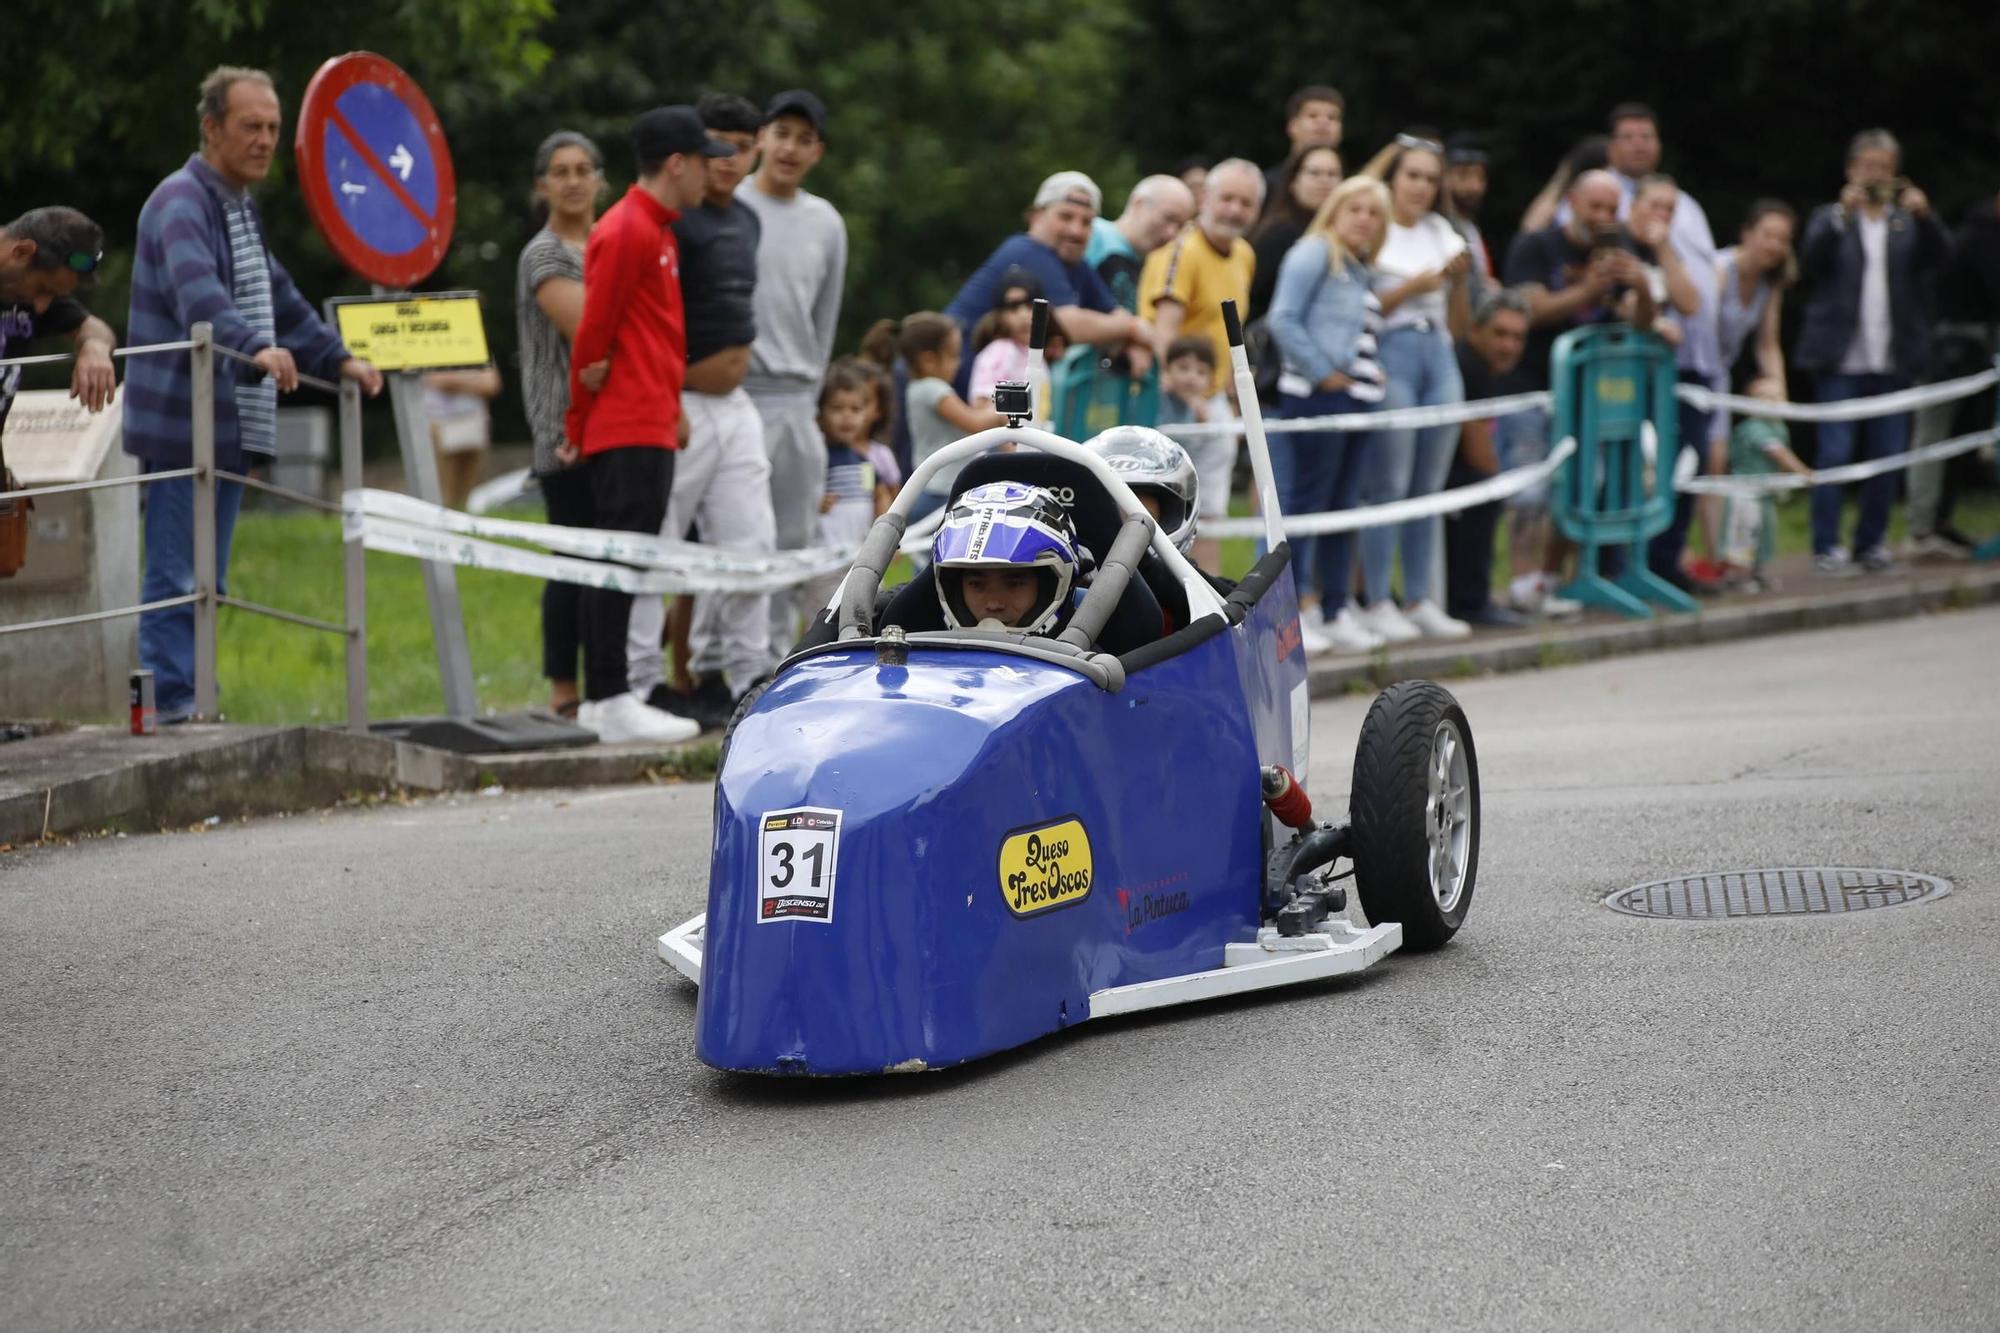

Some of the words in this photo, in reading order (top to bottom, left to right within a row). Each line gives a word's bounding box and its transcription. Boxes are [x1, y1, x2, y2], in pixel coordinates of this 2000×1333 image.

[982, 507, 994, 520] MT
[969, 521, 990, 561] HELMETS
[770, 842, 824, 888] 31
[1026, 834, 1069, 874] Queso
[1128, 900, 1143, 929] La
